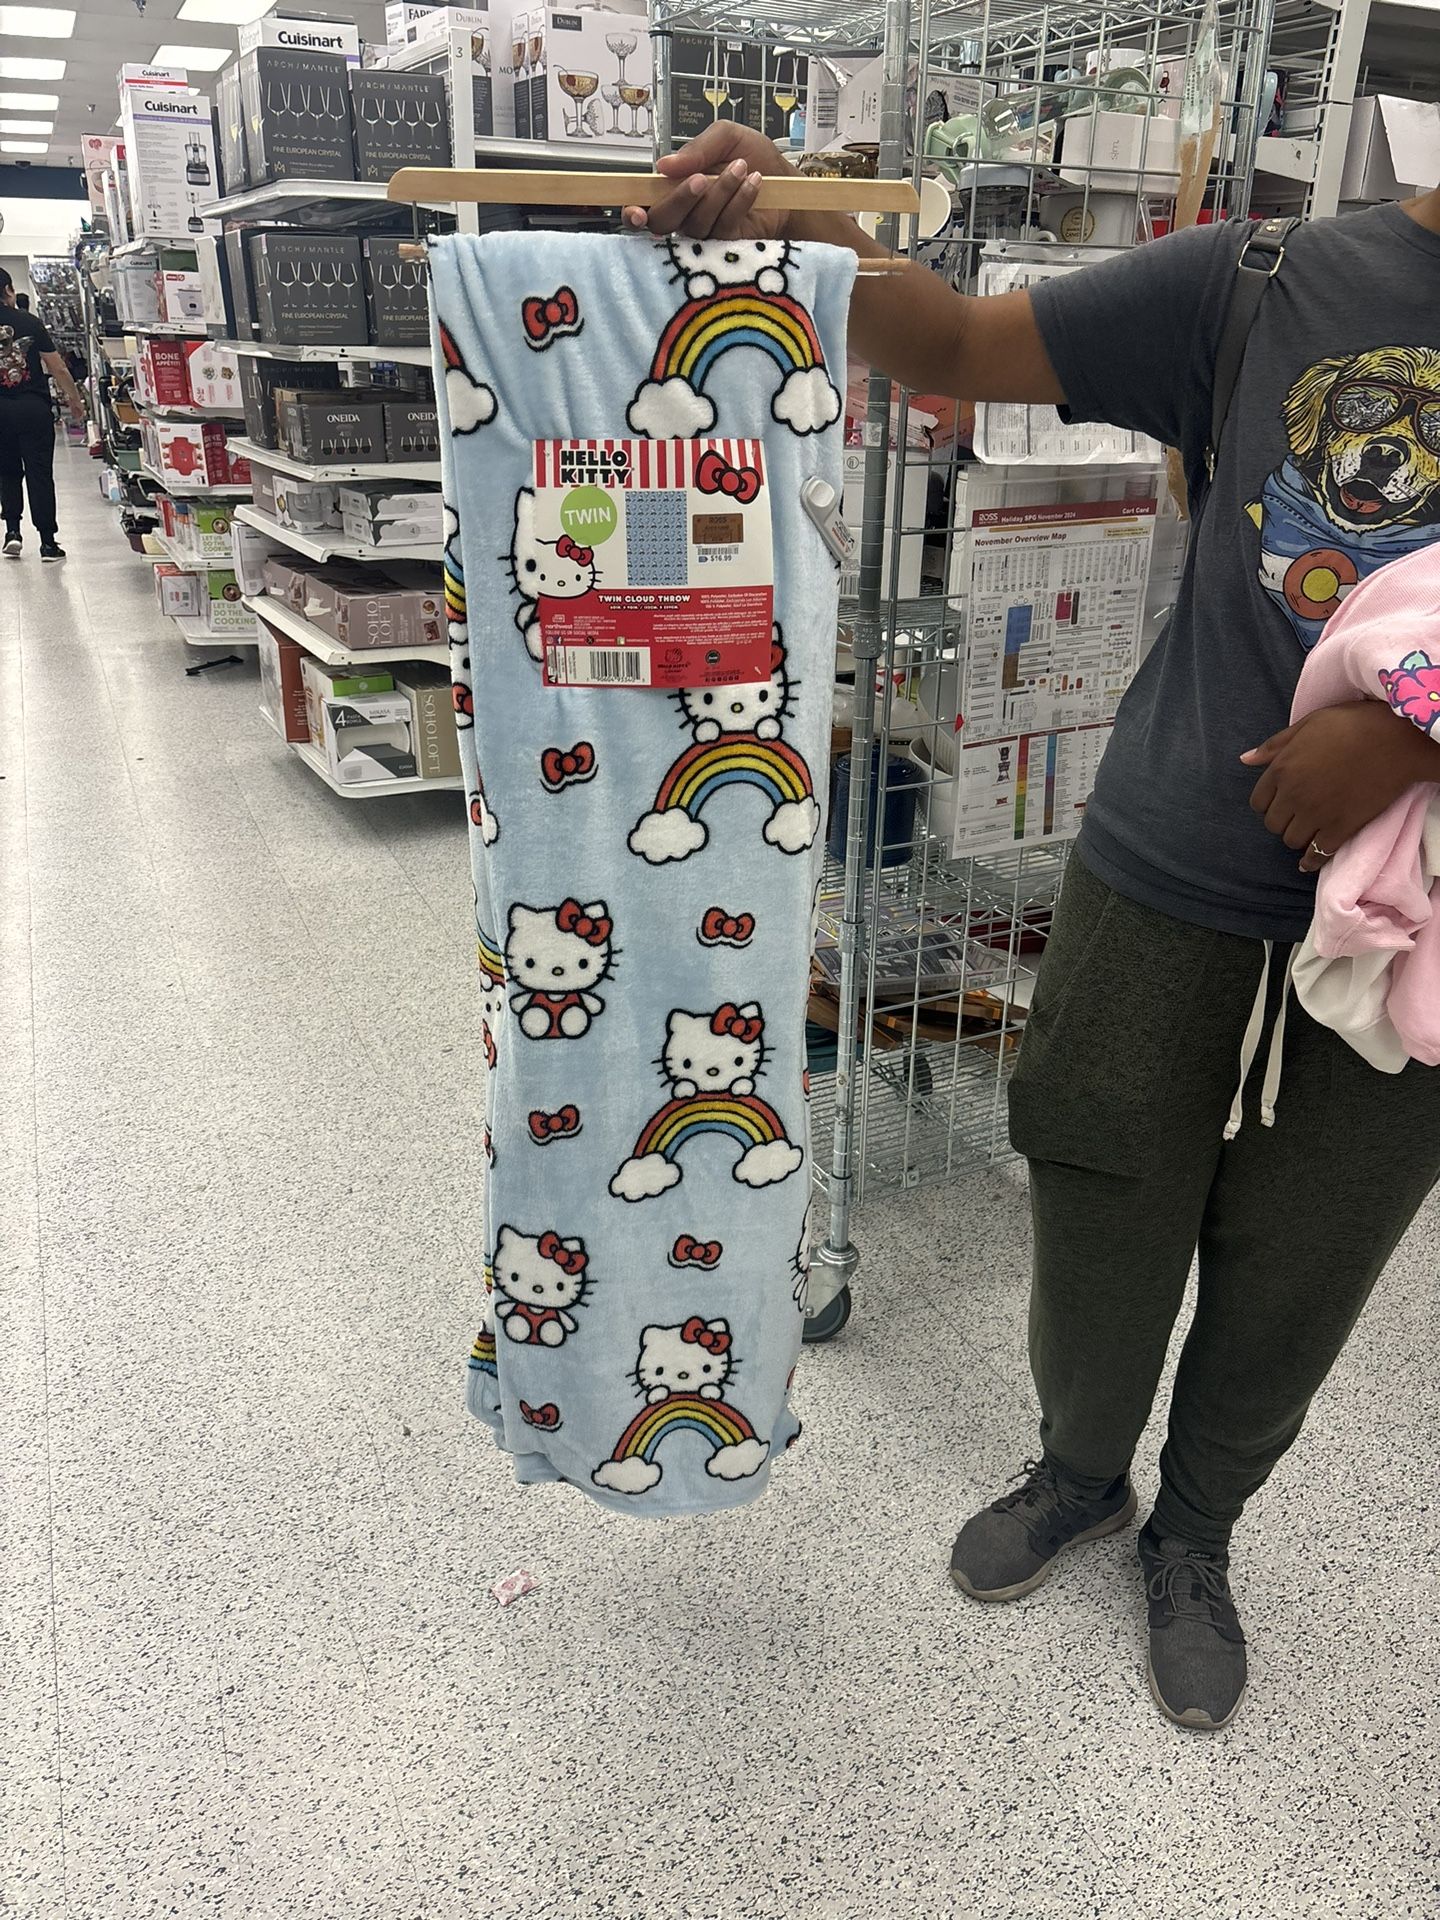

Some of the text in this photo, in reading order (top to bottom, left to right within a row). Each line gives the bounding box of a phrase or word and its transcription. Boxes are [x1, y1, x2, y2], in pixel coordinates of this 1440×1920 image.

[278, 31, 343, 48] Cuisinart
[142, 69, 170, 77] Cuisinart
[144, 100, 199, 115] Cuisinart
[272, 146, 342, 158] FINE EUROPEAN CRYSTAL
[379, 152, 407, 160] EUROPEAN
[408, 153, 431, 161] CRYSTAL
[377, 248, 396, 256] ARC
[155, 352, 180, 360] BONE
[327, 414, 360, 423] ONEIDA
[560, 450, 628, 467] HELLO
[560, 468, 631, 484] KITTY
[564, 506, 612, 526] TWIN
[979, 513, 999, 521] ROSS
[974, 533, 1067, 546] November Overview Map
[599, 595, 622, 603] TWIN
[624, 595, 655, 603] CLOUD
[214, 617, 257, 625] COOKING
[366, 601, 380, 645] SOHO
[378, 601, 392, 644] LOFT
[335, 710, 347, 727] 4
[424, 694, 441, 773] SOHO LOFT
